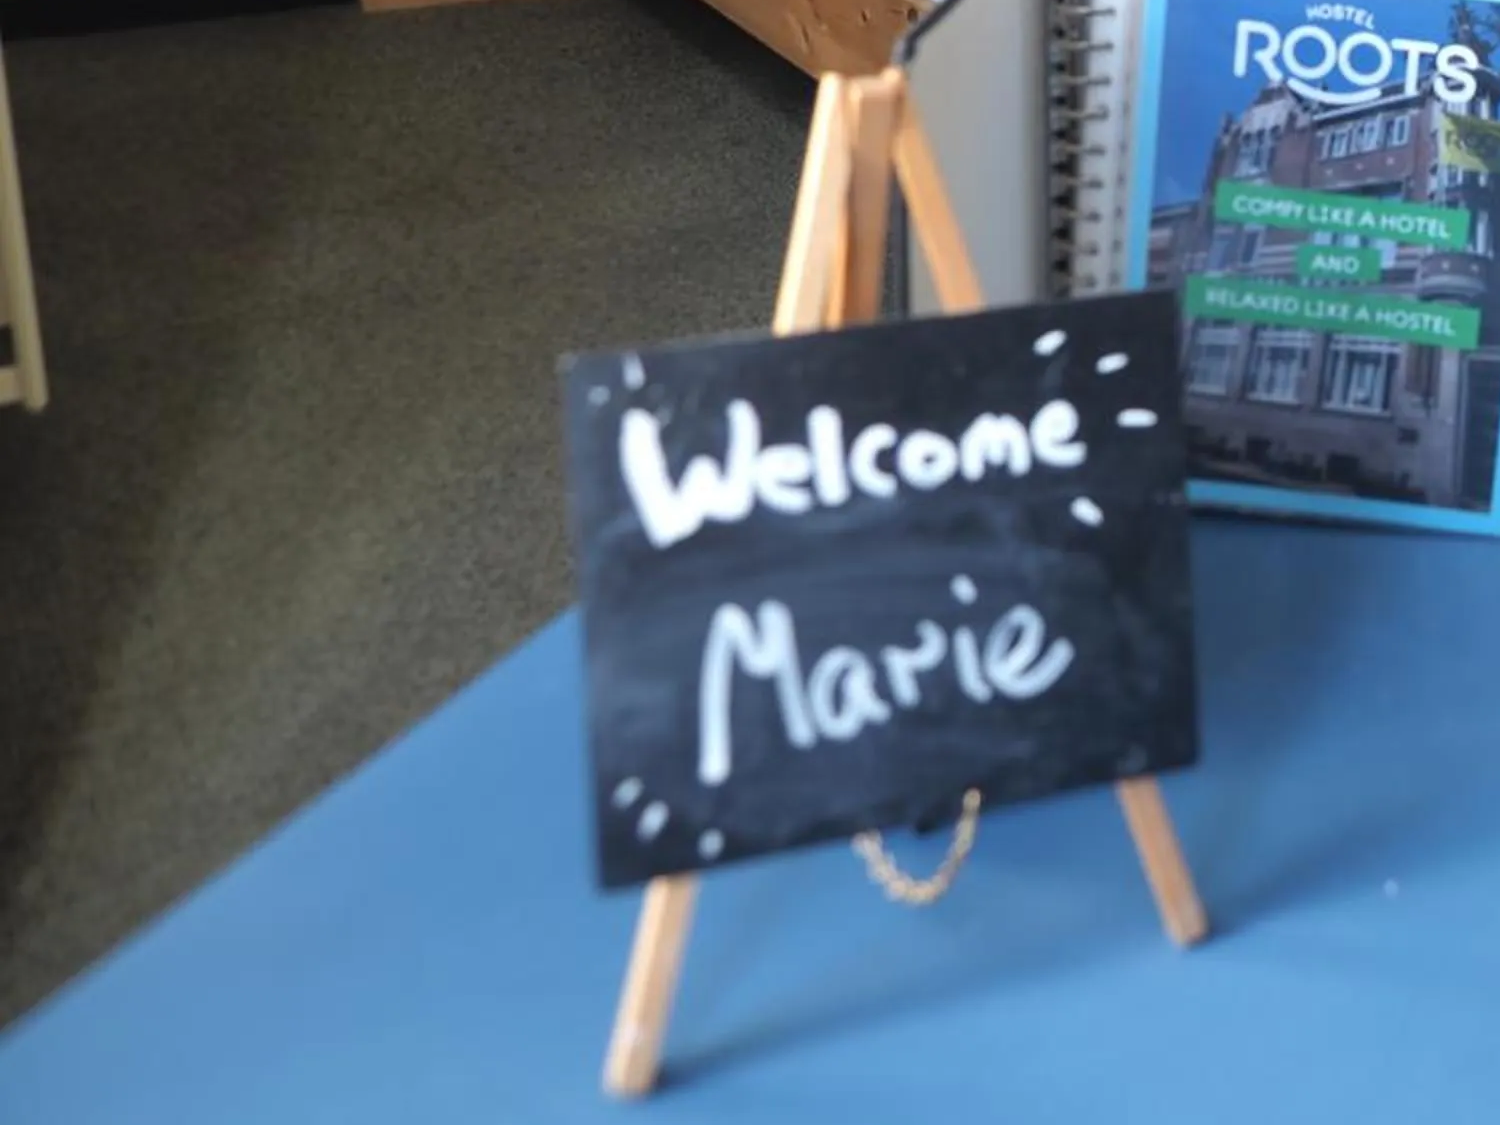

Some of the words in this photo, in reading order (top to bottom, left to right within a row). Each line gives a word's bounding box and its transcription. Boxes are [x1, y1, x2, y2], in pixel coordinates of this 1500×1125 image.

[1306, 2, 1376, 30] HOSTEL
[1233, 19, 1481, 104] ROOTS
[1307, 205, 1356, 227] LIKE
[1359, 210, 1377, 228] A
[1381, 213, 1452, 240] HOTEL
[1311, 254, 1360, 274] AND
[1205, 287, 1299, 315] RELAXED
[1304, 299, 1350, 321] LIKE
[1354, 305, 1371, 323] A
[1375, 306, 1456, 337] HOSTEL
[619, 398, 1087, 548] Welcome
[698, 574, 1075, 786] Marie
